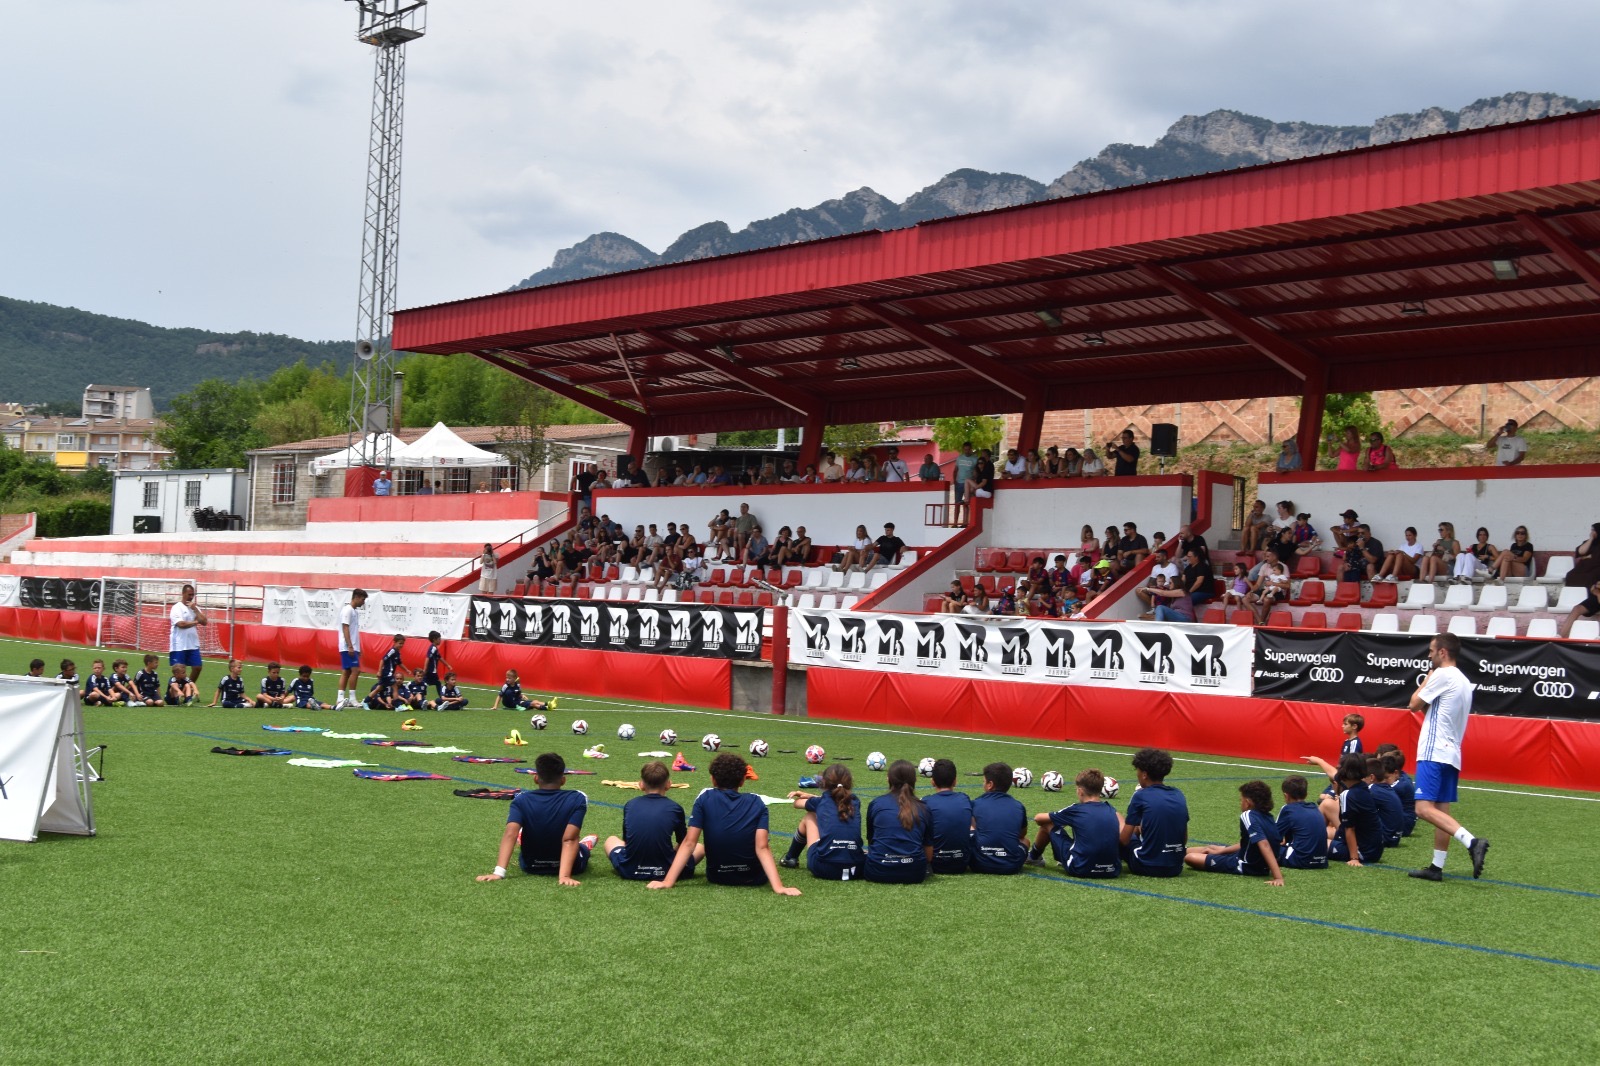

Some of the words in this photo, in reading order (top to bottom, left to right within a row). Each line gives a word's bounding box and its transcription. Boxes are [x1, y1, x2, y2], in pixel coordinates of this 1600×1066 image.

[382, 604, 407, 613] ROCNATION
[423, 606, 449, 616] ROCNATION
[1264, 648, 1336, 666] Superwagen
[1366, 653, 1432, 671] Superwag
[1478, 659, 1566, 679] Superwagen
[1263, 670, 1279, 678] Audi
[1280, 671, 1299, 680] Sport
[1364, 677, 1383, 685] Audi
[1384, 677, 1405, 687] Sport
[1477, 684, 1496, 692] Audi
[1497, 685, 1522, 694] Sport
